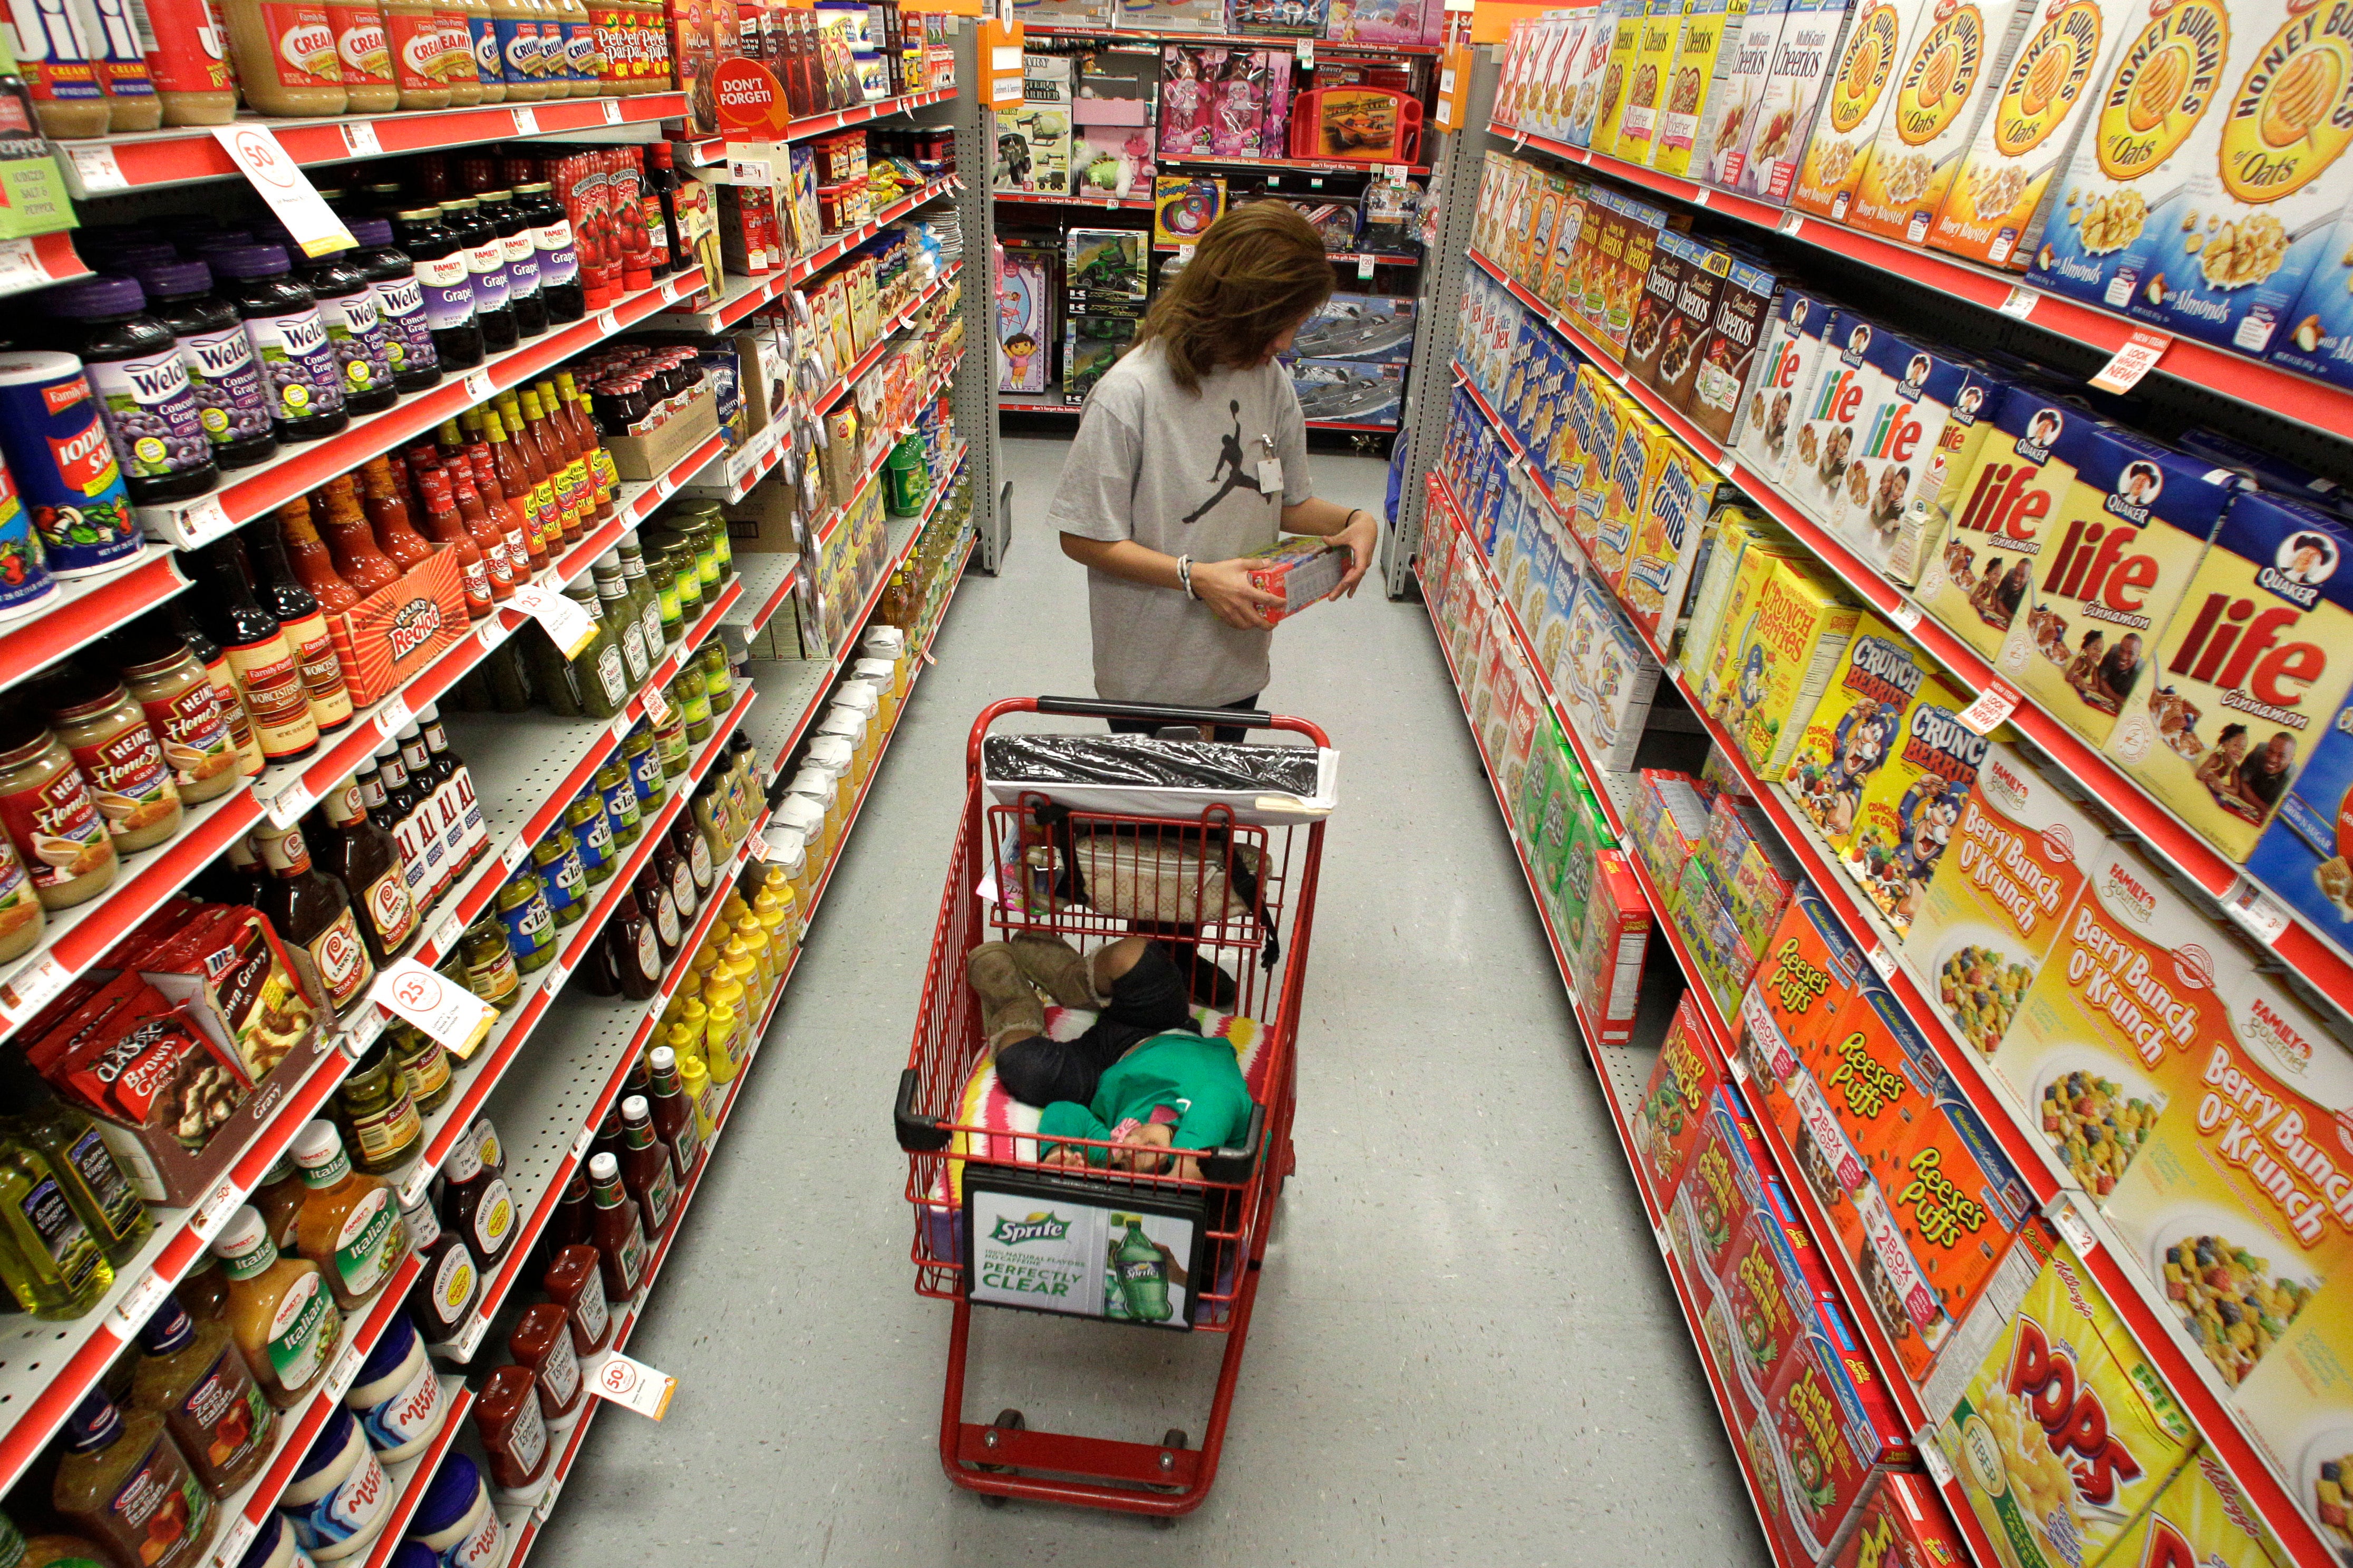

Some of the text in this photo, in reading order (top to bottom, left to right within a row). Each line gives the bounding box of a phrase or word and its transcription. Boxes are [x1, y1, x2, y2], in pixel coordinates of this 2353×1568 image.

[1732, 43, 1767, 75] Cheerios
[1774, 42, 1822, 77] Cheerios
[1904, 5, 1979, 96] HONEY BUNCHES
[2009, 4, 2100, 103] HONEY BUNCHES
[2109, 4, 2221, 116] HONEY BUNCHES
[2239, 14, 2313, 119] HONEY
[720, 90, 772, 105] FORGET!
[722, 77, 762, 92] DON'T
[1906, 111, 1936, 134] Oats
[2008, 121, 2039, 144] Oats
[0, 139, 47, 153] EPPER
[244, 145, 277, 168] 50
[2113, 137, 2157, 166] Oats
[1387, 167, 1395, 176] $8
[2241, 153, 2300, 191] Oats
[1939, 215, 1962, 236] Honey
[513, 262, 538, 276] Grape
[551, 251, 575, 265] Grape
[2060, 253, 2103, 286] Almonds
[442, 289, 472, 304] Grape
[483, 274, 508, 289] Grape
[1716, 300, 1755, 347] Cheerios
[2175, 288, 2232, 325] Almonds
[2127, 347, 2152, 362] LOOK
[2132, 332, 2147, 344] NEW
[1760, 340, 1801, 389] life
[2105, 365, 2137, 383] NEW!
[2116, 356, 2147, 371] WHAT'S
[1810, 369, 1864, 423] life
[1862, 403, 1923, 462] life
[2016, 439, 2049, 464] QUAKER
[1958, 462, 2052, 540] life
[2107, 495, 2149, 525] QUAKER
[1987, 531, 2040, 554] Cinnamon
[2042, 518, 2160, 612] life
[2260, 567, 2319, 607] QUAKER
[2082, 600, 2151, 629] Cinnamon
[1853, 636, 1924, 695] CRUNCH
[2168, 591, 2327, 708] life
[1843, 667, 1912, 714] BERRIES
[1986, 695, 2007, 712] LOOK
[2219, 689, 2309, 729] Cinnamon
[1969, 708, 1997, 727] NEW!
[1977, 702, 2005, 719] WHAT'S
[110, 727, 152, 759] HEINZ
[1911, 703, 1988, 765] CRUNC
[1902, 739, 1979, 786] BERRIE
[1963, 801, 2065, 921] Berry Bunch
[2109, 862, 2156, 910] FAMILY
[1776, 937, 1832, 995] Reese's
[2074, 906, 2134, 975] Berry
[2125, 952, 2199, 1047] Bunch
[399, 981, 424, 1005] 25
[1767, 967, 1813, 1012] Puffs
[2250, 997, 2314, 1060] FAMILY
[123, 1038, 177, 1090] Brown
[135, 1054, 182, 1097] Gravy
[1837, 1032, 1906, 1104] Reese's
[1829, 1064, 1885, 1118] Puffs
[1809, 1107, 1843, 1150] 2 BOX
[1909, 1148, 1988, 1232] Reese's
[998, 1219, 1063, 1242] Sprite
[1898, 1181, 1961, 1248] Puffs
[350, 1212, 391, 1259] Italian
[1875, 1225, 1913, 1278] 2 BOX
[983, 1261, 1083, 1283] PERFECTLY
[1001, 1255, 1041, 1265] CAFFEINE
[1006, 1252, 1044, 1262] NATURAL
[982, 1273, 1069, 1297] CLEAR
[2054, 1259, 2094, 1320] Kellogg's
[283, 1298, 324, 1350] Italian
[607, 1370, 624, 1389] 50
[1967, 1425, 2000, 1487] FIBER
[2200, 1450, 2261, 1539] Kellogg's
